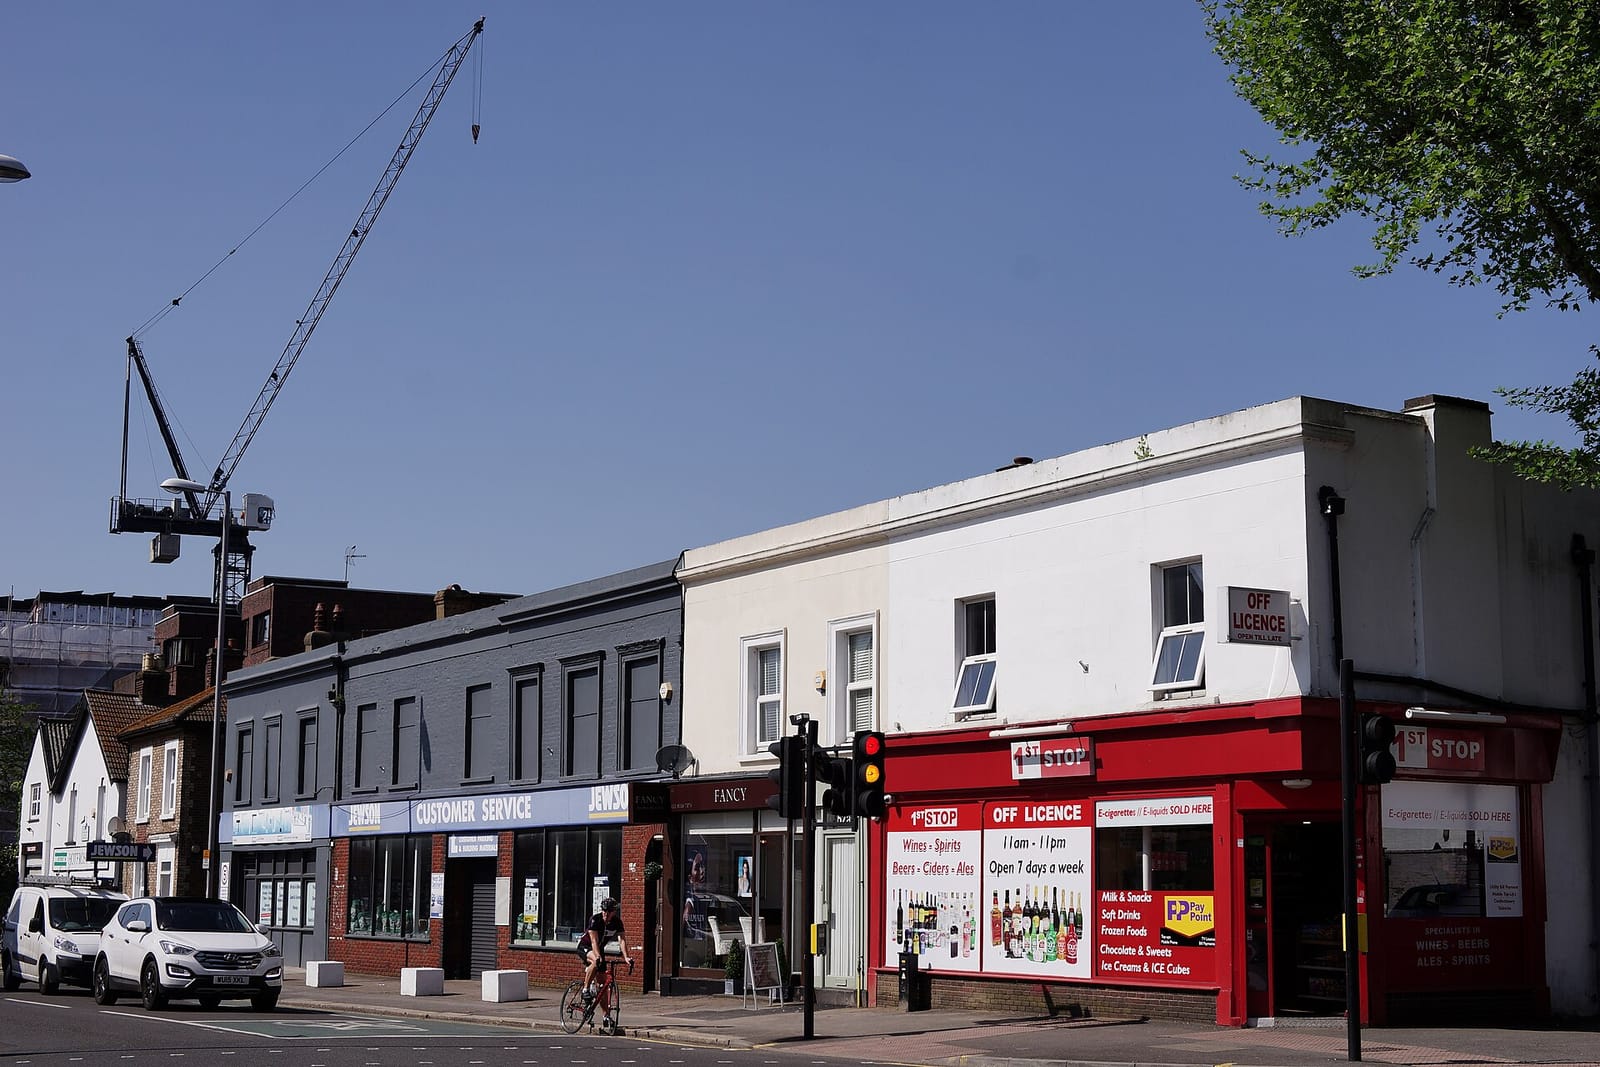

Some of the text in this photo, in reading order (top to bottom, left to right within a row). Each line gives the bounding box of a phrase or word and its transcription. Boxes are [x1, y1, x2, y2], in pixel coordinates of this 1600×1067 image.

[1248, 592, 1271, 610] OFF
[1233, 612, 1286, 632] LICENCE
[1392, 730, 1480, 762] 1ST STOP
[1014, 746, 1086, 774] 1ST STOP
[714, 787, 747, 802] FANCY
[348, 802, 381, 826] JEWSON
[416, 796, 532, 825] CUSTOMER SERVICE
[993, 804, 1081, 822] OFF LICENCE
[1098, 808, 1136, 819] E-cigarettes
[1143, 806, 1168, 817] E-liquids
[1169, 805, 1190, 814] SOLD
[1192, 804, 1212, 814] HERE
[1388, 808, 1432, 820] E-cigarettes
[1468, 811, 1489, 821] SOLD
[1491, 812, 1511, 822] HERE
[911, 811, 956, 826] 1ST STOP
[90, 845, 138, 857] JEWSON
[903, 838, 927, 852] Wines
[934, 838, 961, 856] Spirits
[1004, 835, 1029, 849] 11am
[1040, 835, 1066, 853] 11pm
[892, 861, 915, 875] Beers
[923, 861, 949, 875] Ciders
[956, 861, 974, 875] Ales
[989, 860, 1084, 878] Open 7 days a week
[1101, 892, 1152, 902] Milk & Snacks
[1101, 909, 1141, 921] Soft Drinks
[1190, 902, 1204, 913] Pay
[1190, 912, 1212, 921] Point
[1101, 925, 1147, 936] Frozen Foods
[1425, 927, 1471, 936] SPECIALISTS
[1100, 944, 1172, 957] Chocolate & Sweets
[1416, 940, 1449, 951] WINES
[1458, 938, 1490, 949] BEERS
[1101, 960, 1190, 975] Ice Creams & ICE Cubes
[1417, 956, 1442, 967] ALES
[1451, 954, 1491, 966] SPIRITS
